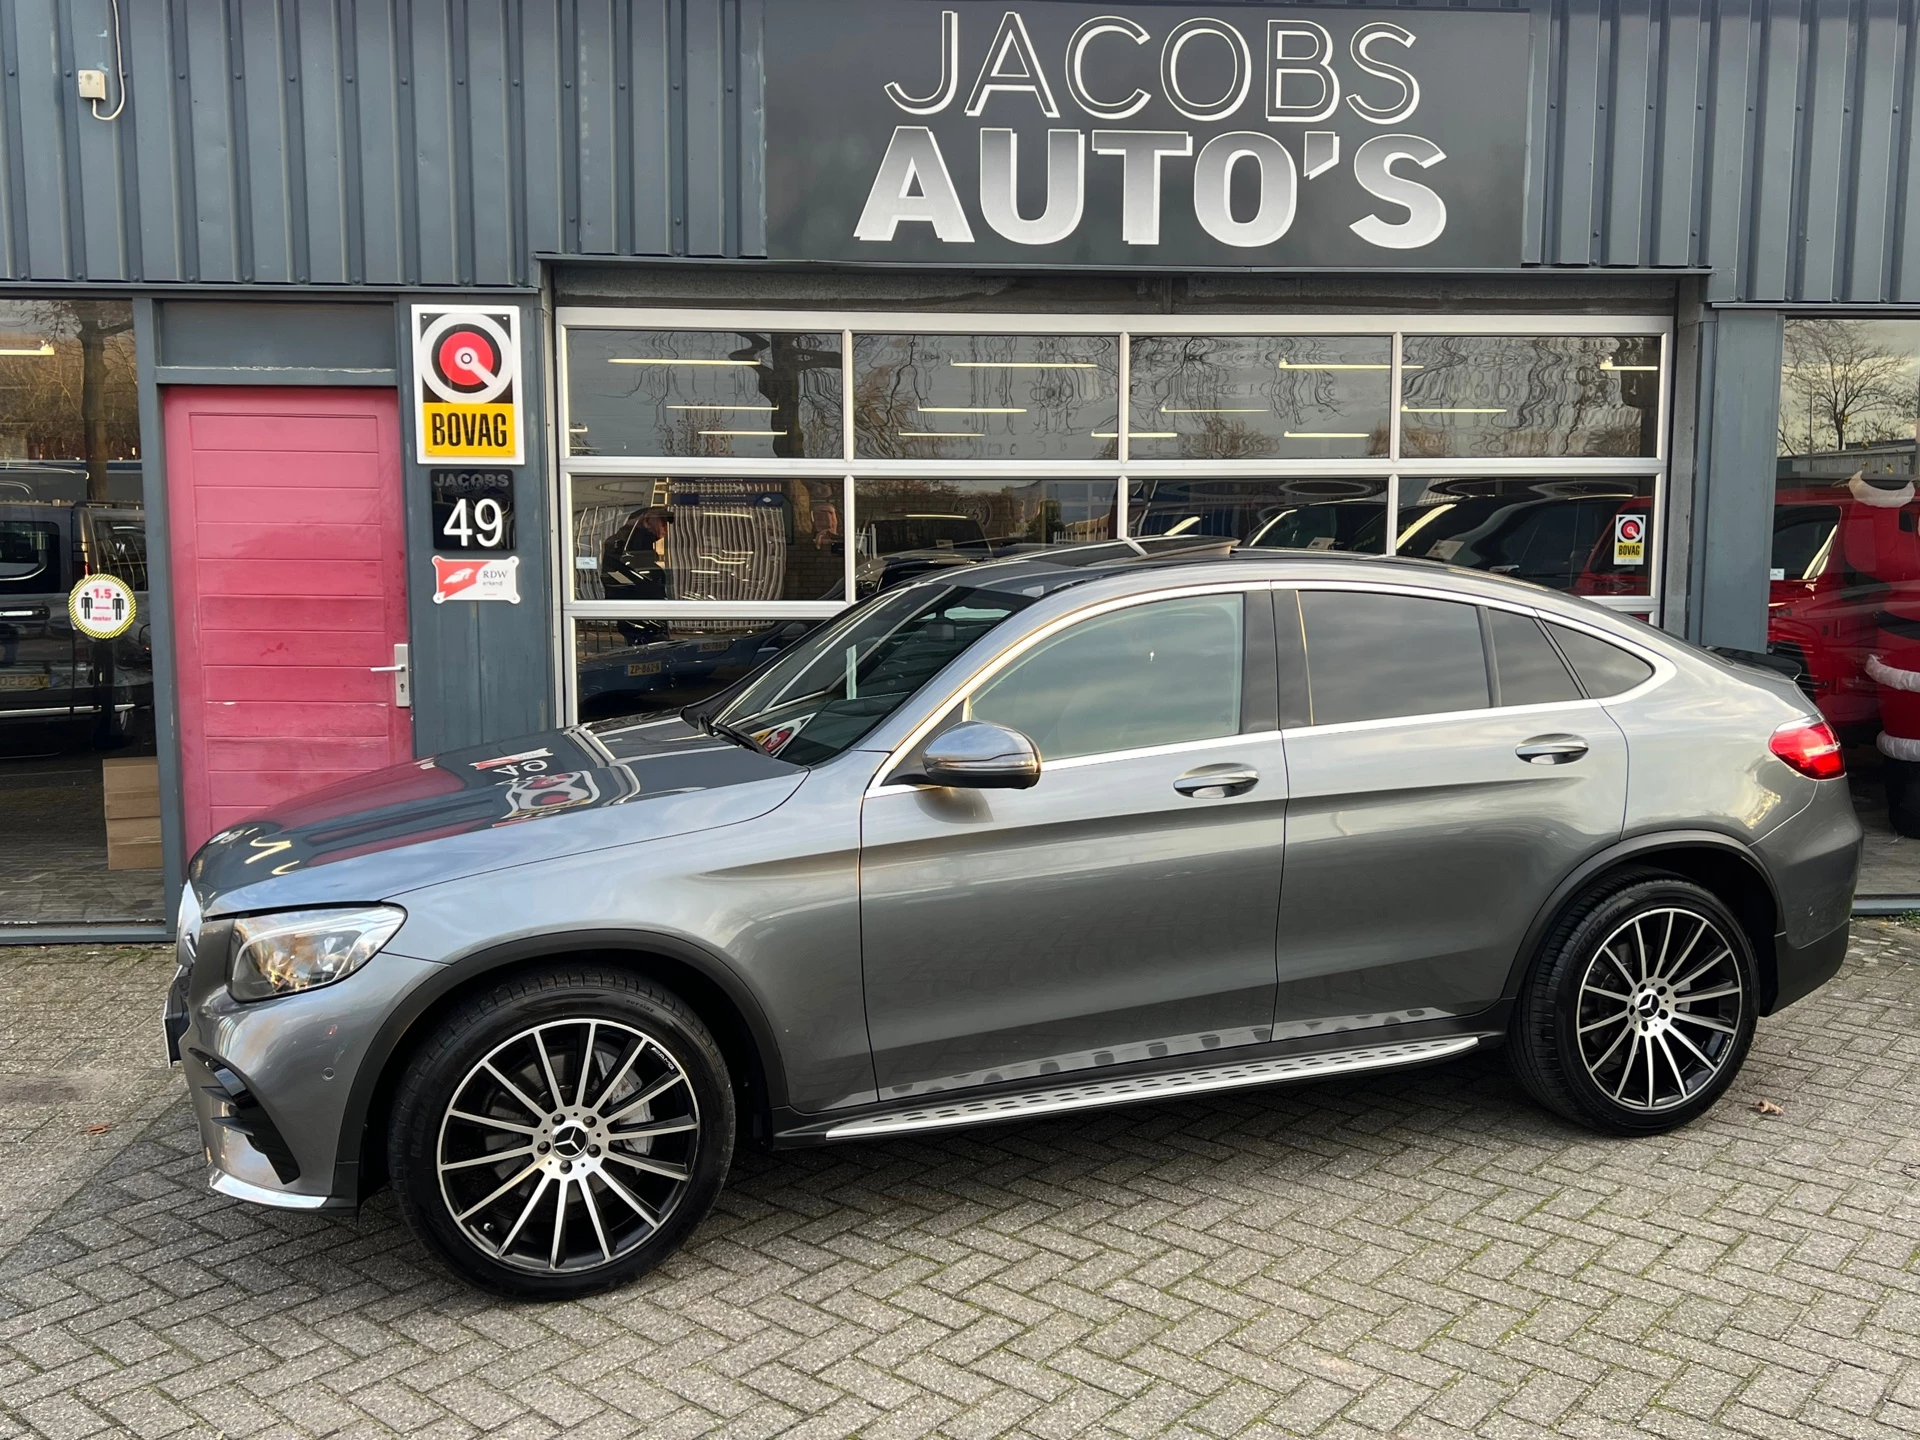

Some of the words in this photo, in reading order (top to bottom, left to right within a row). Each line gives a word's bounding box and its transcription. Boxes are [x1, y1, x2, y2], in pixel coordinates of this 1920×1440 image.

[884, 10, 1420, 124] JACOBS
[853, 125, 1447, 249] AUTO'S
[431, 412, 507, 447] BOVAG
[433, 473, 510, 487] JACOBS
[443, 498, 503, 547] 49
[1618, 545, 1640, 556] BOVAG
[483, 570, 508, 579] RDW
[93, 588, 112, 599] 1.5
